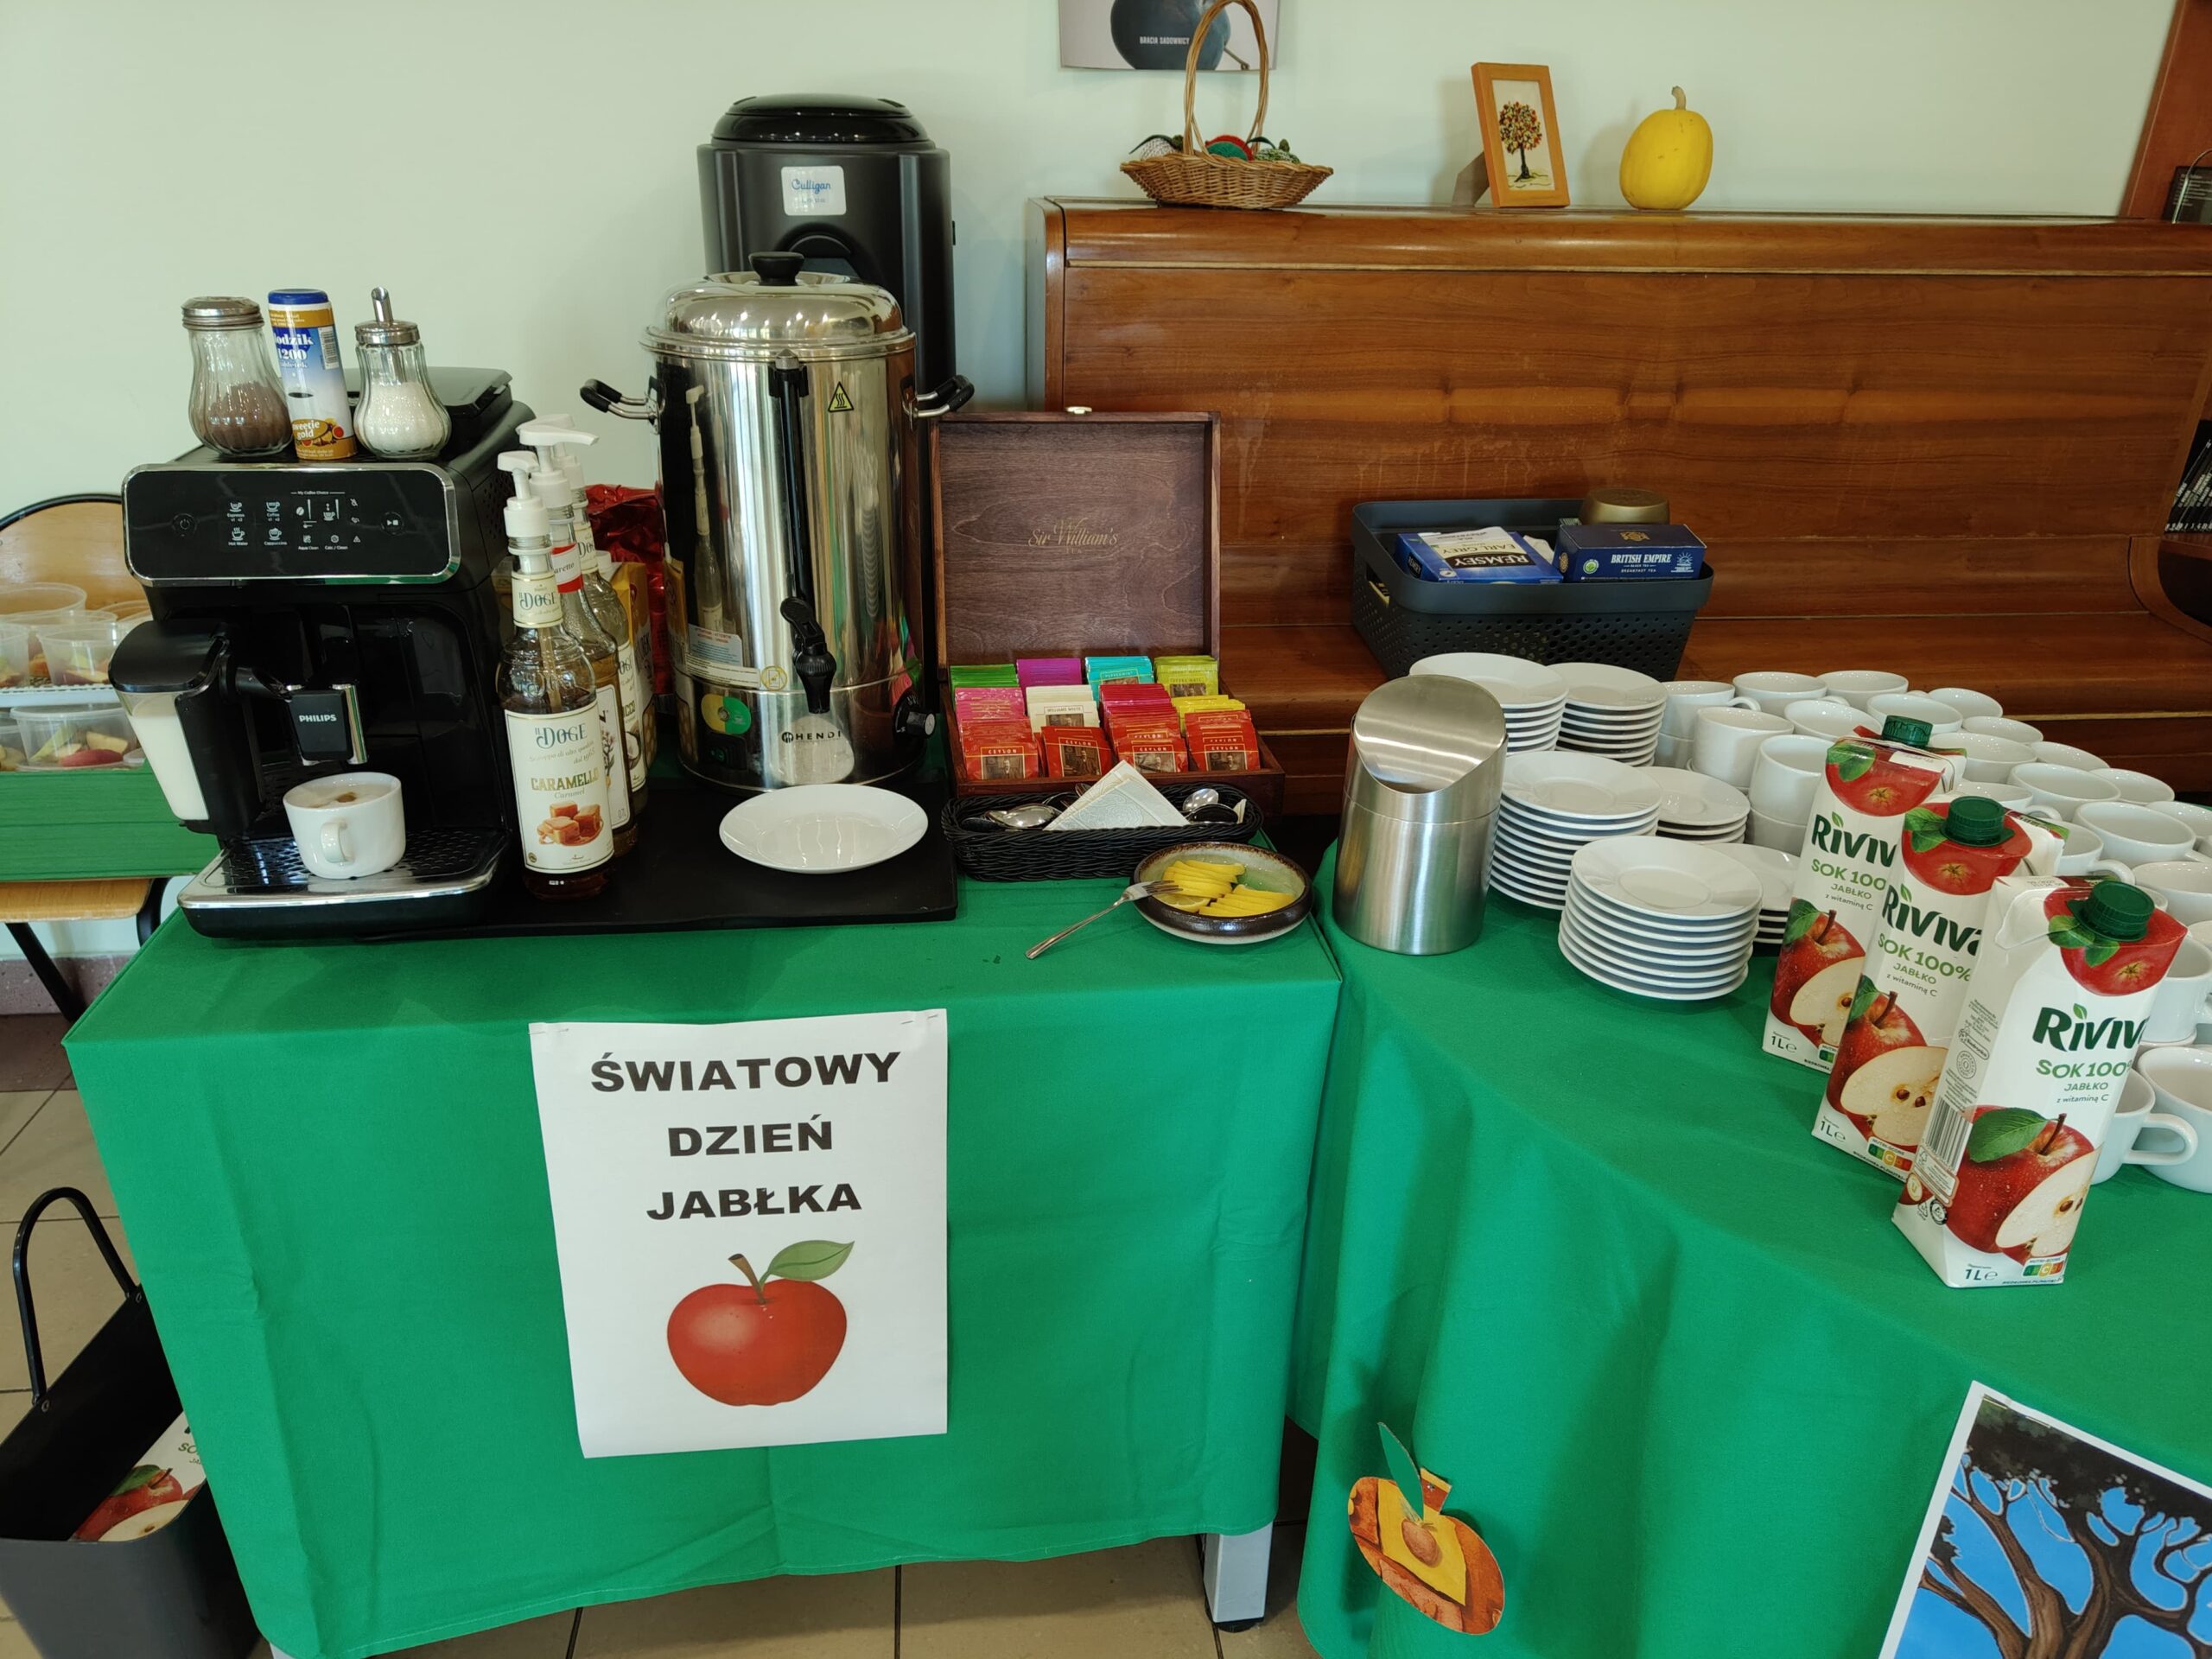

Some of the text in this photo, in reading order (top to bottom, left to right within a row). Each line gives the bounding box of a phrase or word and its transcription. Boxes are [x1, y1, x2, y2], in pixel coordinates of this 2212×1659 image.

[1160, 36, 1190, 45] SADOWNICY
[791, 178, 831, 194] Culligan
[277, 348, 307, 360] 1200
[297, 428, 314, 441] gold
[1028, 517, 1119, 547] Sir William's
[1443, 543, 1516, 554] EARL GREY
[1455, 555, 1529, 566] REMSEY
[1611, 554, 1672, 563] BRITISH EMPIRE
[554, 563, 575, 575] aretto
[537, 723, 588, 749] DOGE
[795, 730, 841, 741] HENDI
[531, 767, 600, 791] CARAMELLO
[1811, 859, 1887, 891] SOK 100
[1830, 883, 1872, 900] JABŁKO
[1831, 895, 1865, 910] witaminą
[1878, 933, 1972, 982] SOK 100%
[1893, 963, 1937, 985] JABŁKO
[1892, 974, 1928, 995] witaminą
[590, 1051, 901, 1092] ŚWIATOWY
[2036, 1059, 2085, 1079] SOK
[2064, 1082, 2109, 1092] JABŁKO
[2063, 1094, 2099, 1103] witaminą
[668, 1114, 833, 1157] DZIEŃ
[647, 1183, 862, 1221] JABŁKA
[178, 1442, 197, 1454] SO
